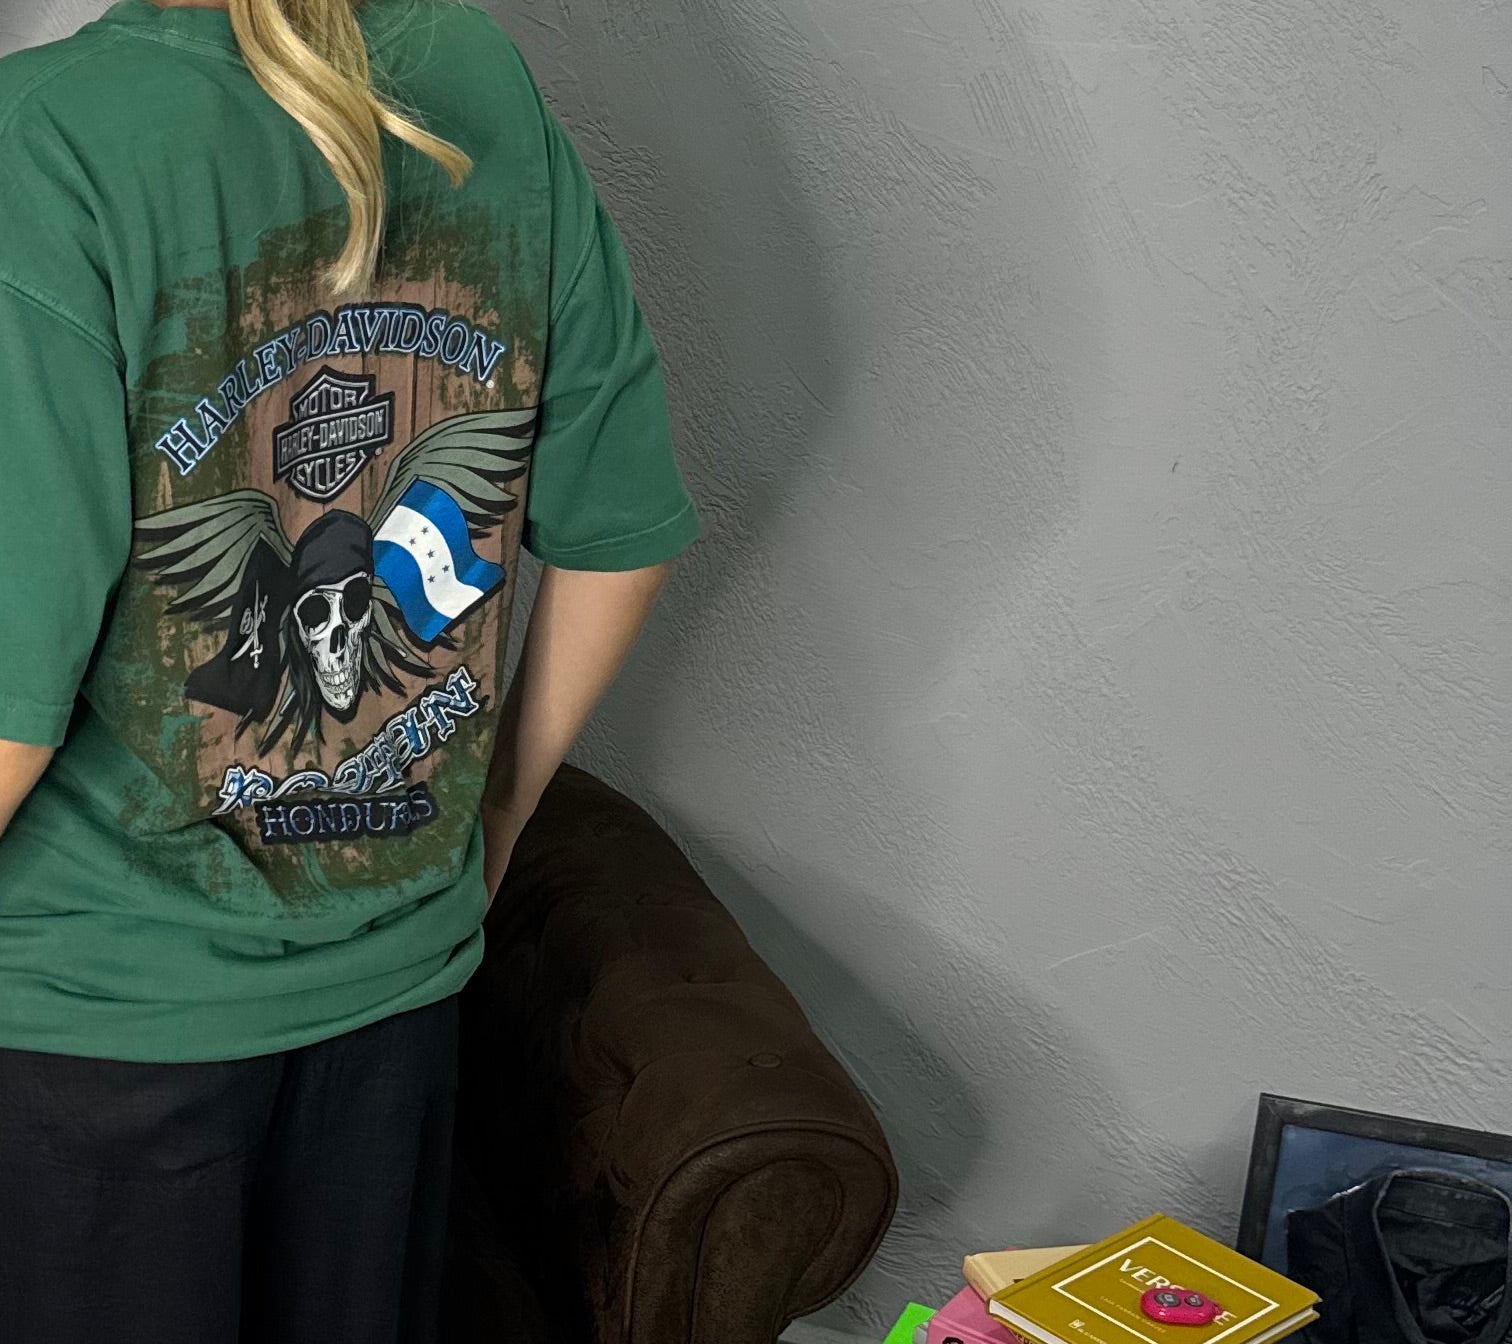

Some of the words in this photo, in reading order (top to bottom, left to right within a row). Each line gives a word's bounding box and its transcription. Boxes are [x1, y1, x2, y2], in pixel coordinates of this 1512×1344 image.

[155, 307, 504, 476] HARLEY-DAVIDSON
[298, 386, 358, 419] MOTOR
[279, 409, 385, 458] HARLEY-DAVIDSON
[296, 456, 355, 491] CYCLES
